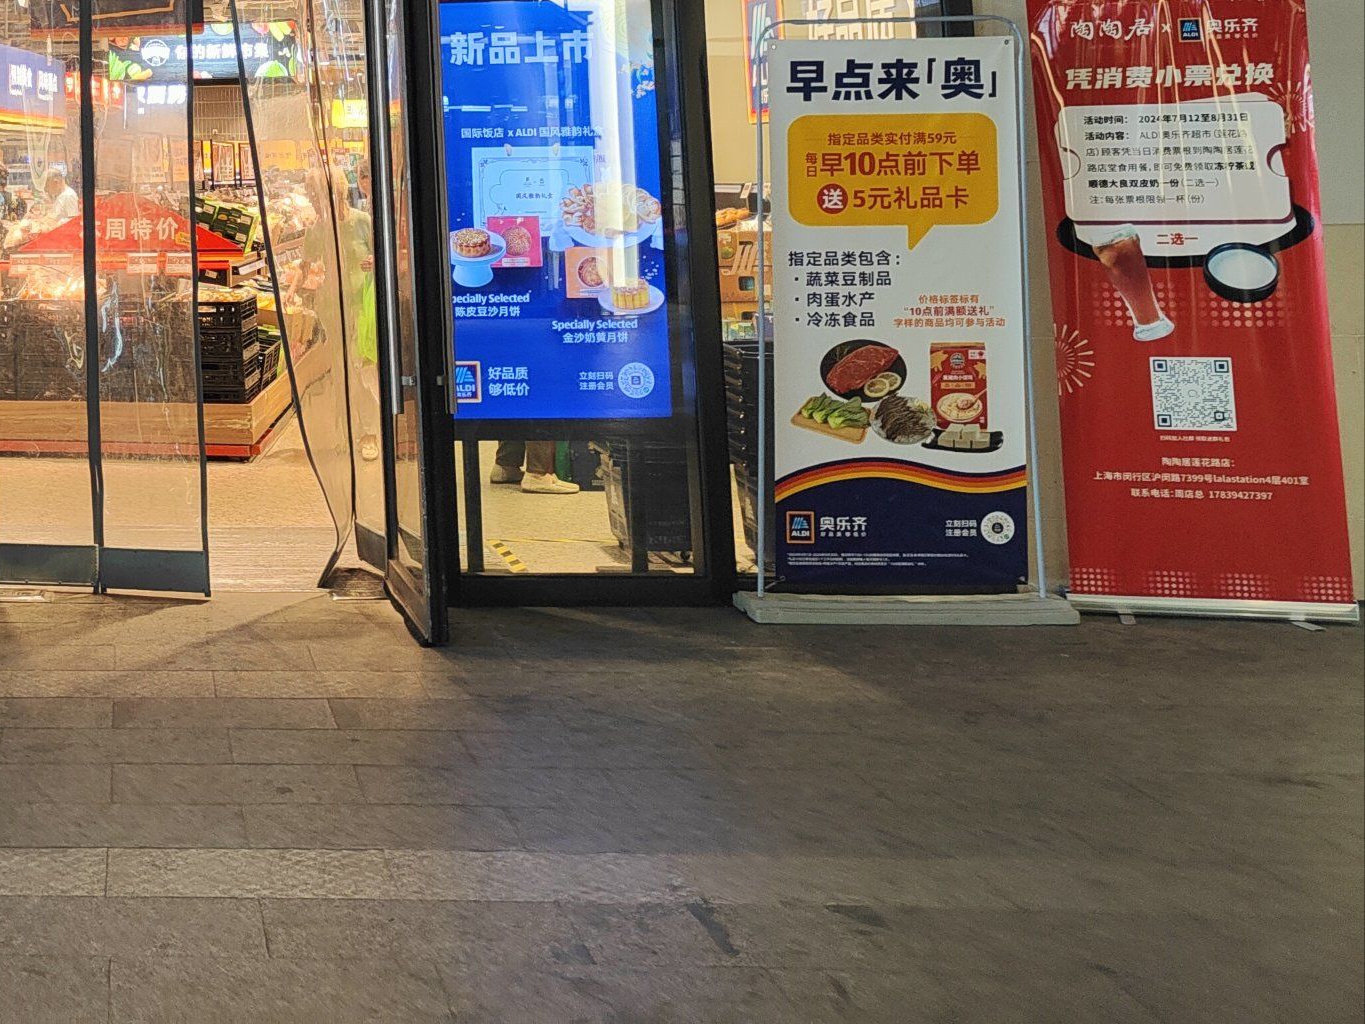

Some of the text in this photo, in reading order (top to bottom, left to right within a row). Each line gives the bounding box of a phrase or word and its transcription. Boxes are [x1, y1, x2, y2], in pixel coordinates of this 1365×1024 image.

[1208, 18, 1259, 33] 奥乐齐
[450, 29, 595, 66] 新品上市
[1065, 62, 1275, 90] 凭消费小票兑换
[461, 127, 504, 139] 国际饭店
[515, 128, 538, 137] ALDI
[827, 132, 958, 146] 指定品类实付满59元
[819, 150, 982, 177] 早10点前下单
[821, 185, 971, 210] 送 5元礼品卡
[1156, 233, 1198, 245] 二选一
[788, 250, 901, 267] 指定品类包含：
[805, 271, 892, 287] 蔬菜豆制品
[452, 293, 486, 304] pecially
[806, 291, 876, 308] 肉蛋水产
[918, 294, 980, 304] 价格标签标有
[455, 306, 521, 317] 陈皮豆沙月饼
[551, 318, 639, 331] Specially Selected
[806, 312, 876, 328] 冷冻食品
[892, 317, 1007, 328] 字样的商品均可参与活动
[562, 332, 629, 343] 金沙奶黄月饼
[488, 366, 529, 380] 好品质
[488, 382, 530, 396] 够低价
[579, 380, 615, 391] 注册会员
[1209, 488, 1274, 500] 17839427397
[820, 516, 868, 532] 奥乐齐
[790, 529, 811, 537] ALDI
[945, 528, 978, 537] 注册会员
